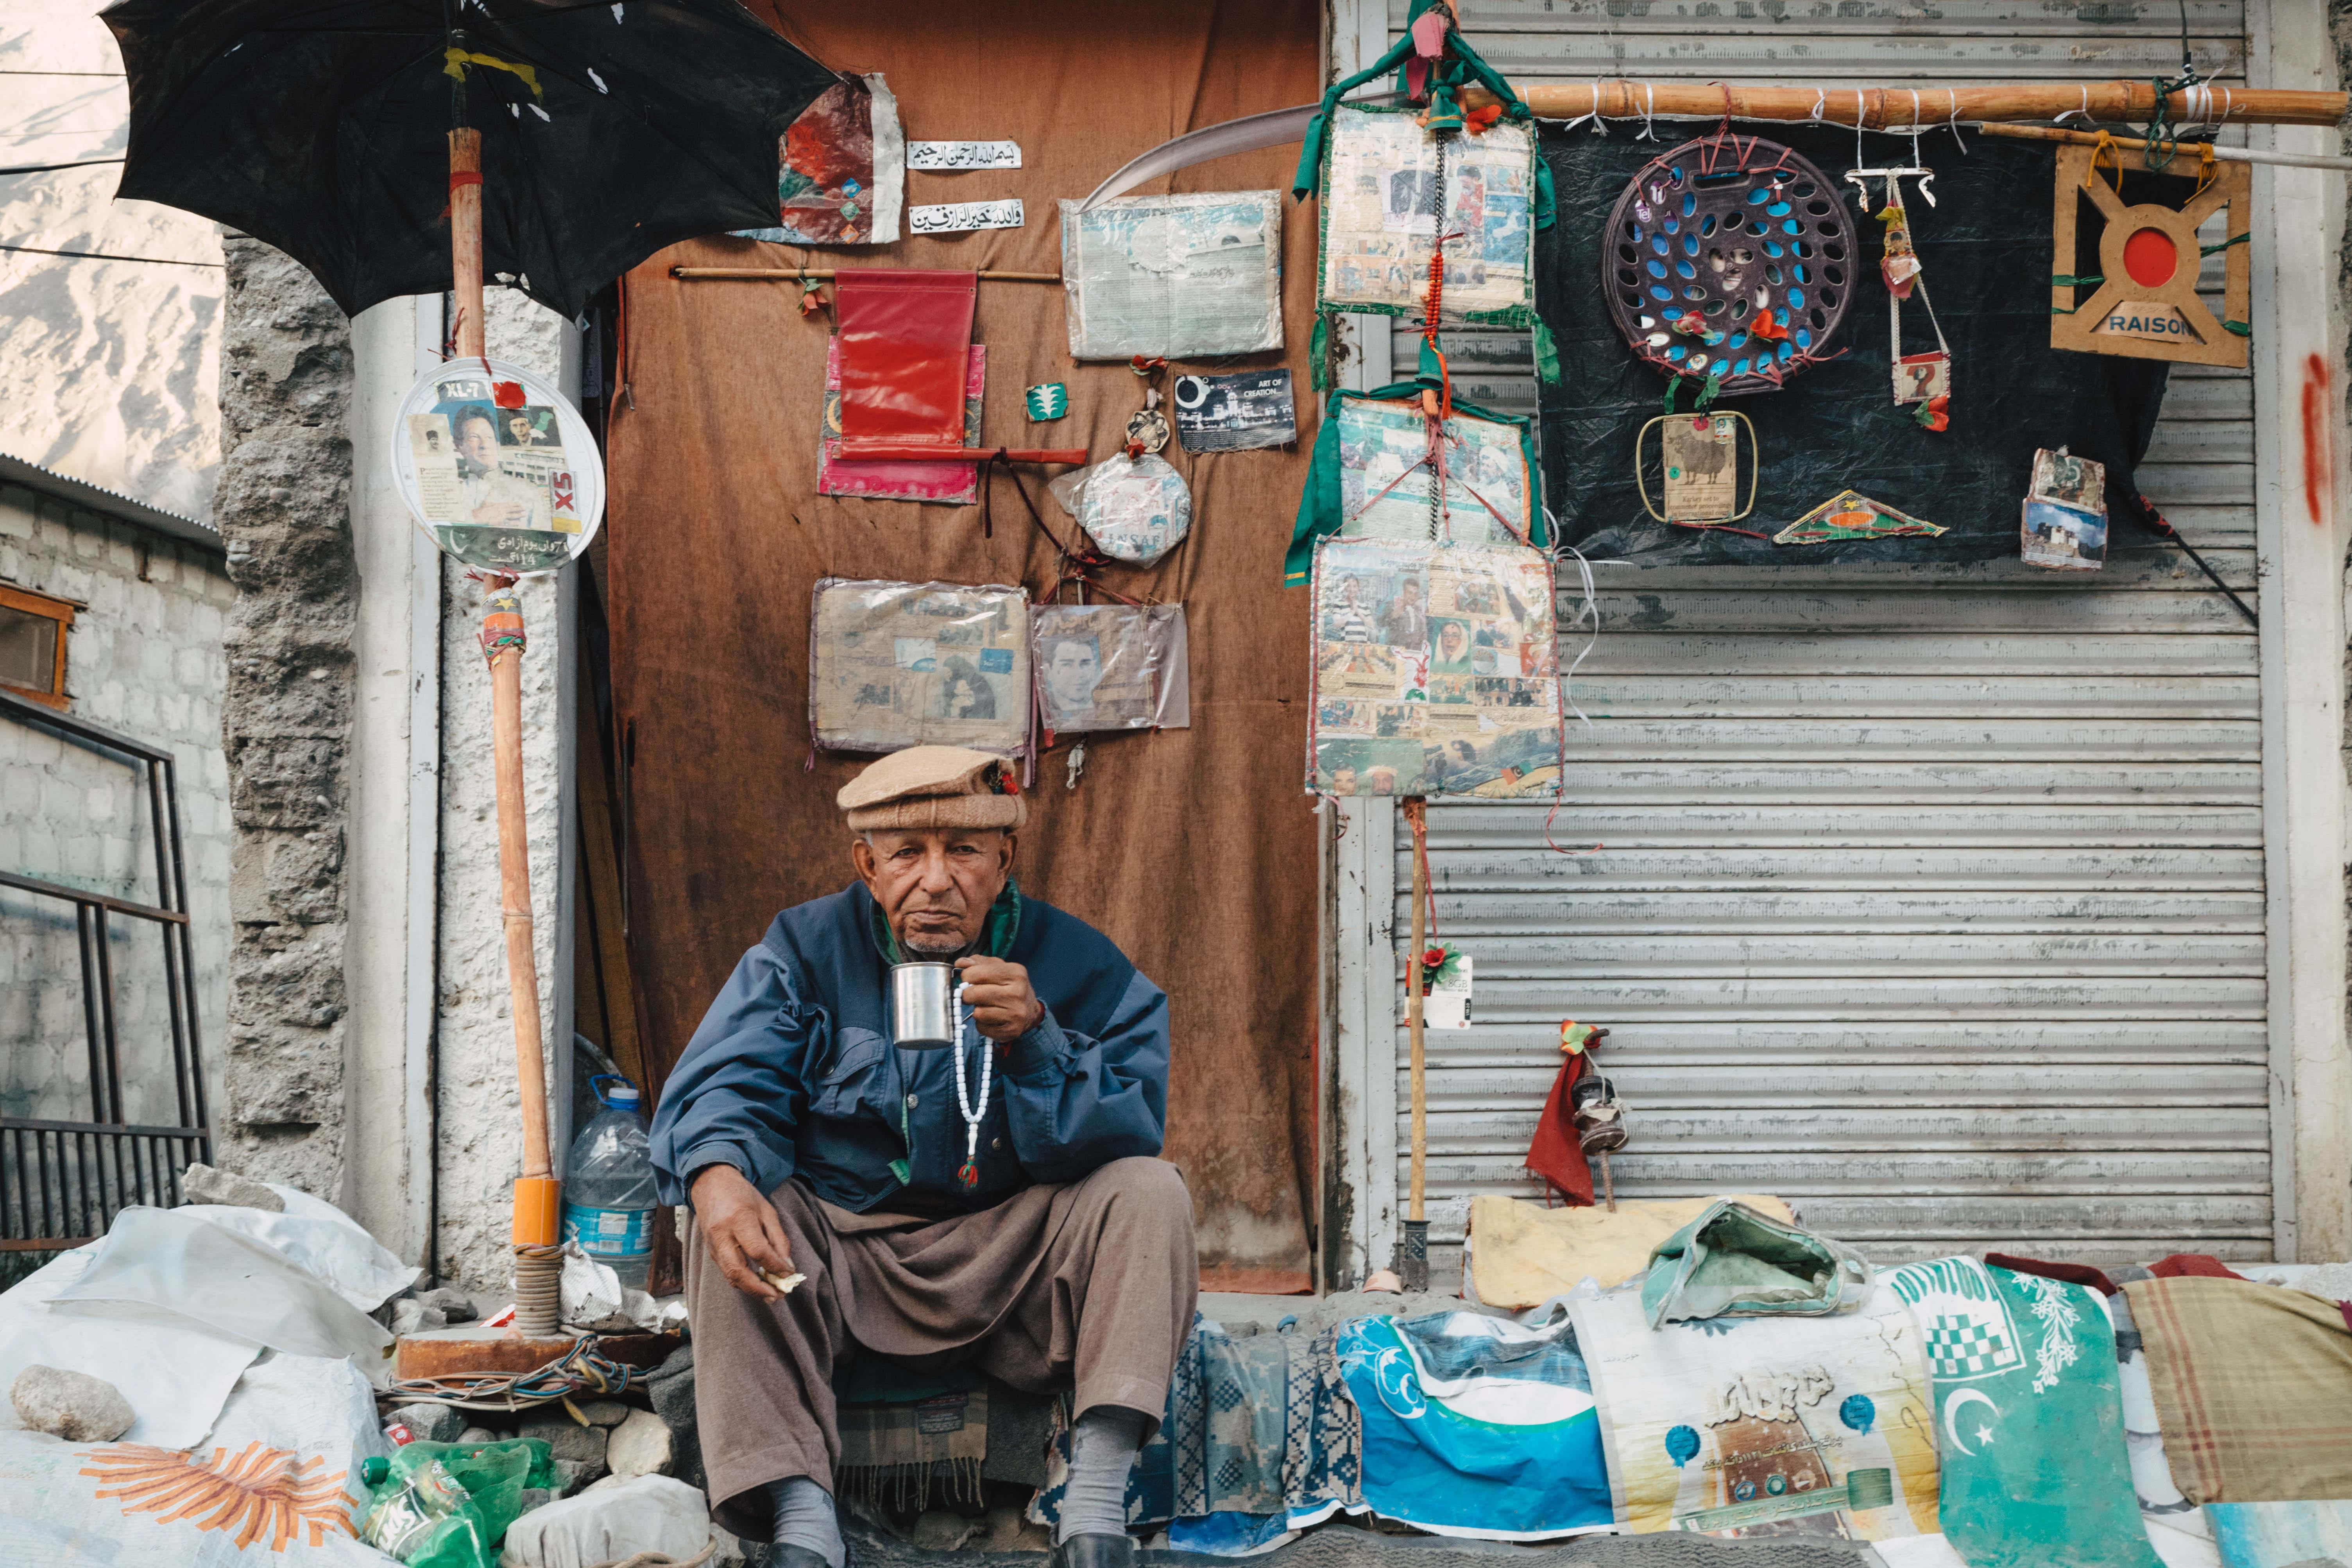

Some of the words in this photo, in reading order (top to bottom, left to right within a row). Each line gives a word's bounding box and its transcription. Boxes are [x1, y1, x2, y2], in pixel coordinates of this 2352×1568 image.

[2109, 315, 2193, 337] RAISON
[445, 382, 479, 397] XL-7
[1109, 533, 1160, 546] INSAF
[1448, 979, 1468, 988] 8GB
